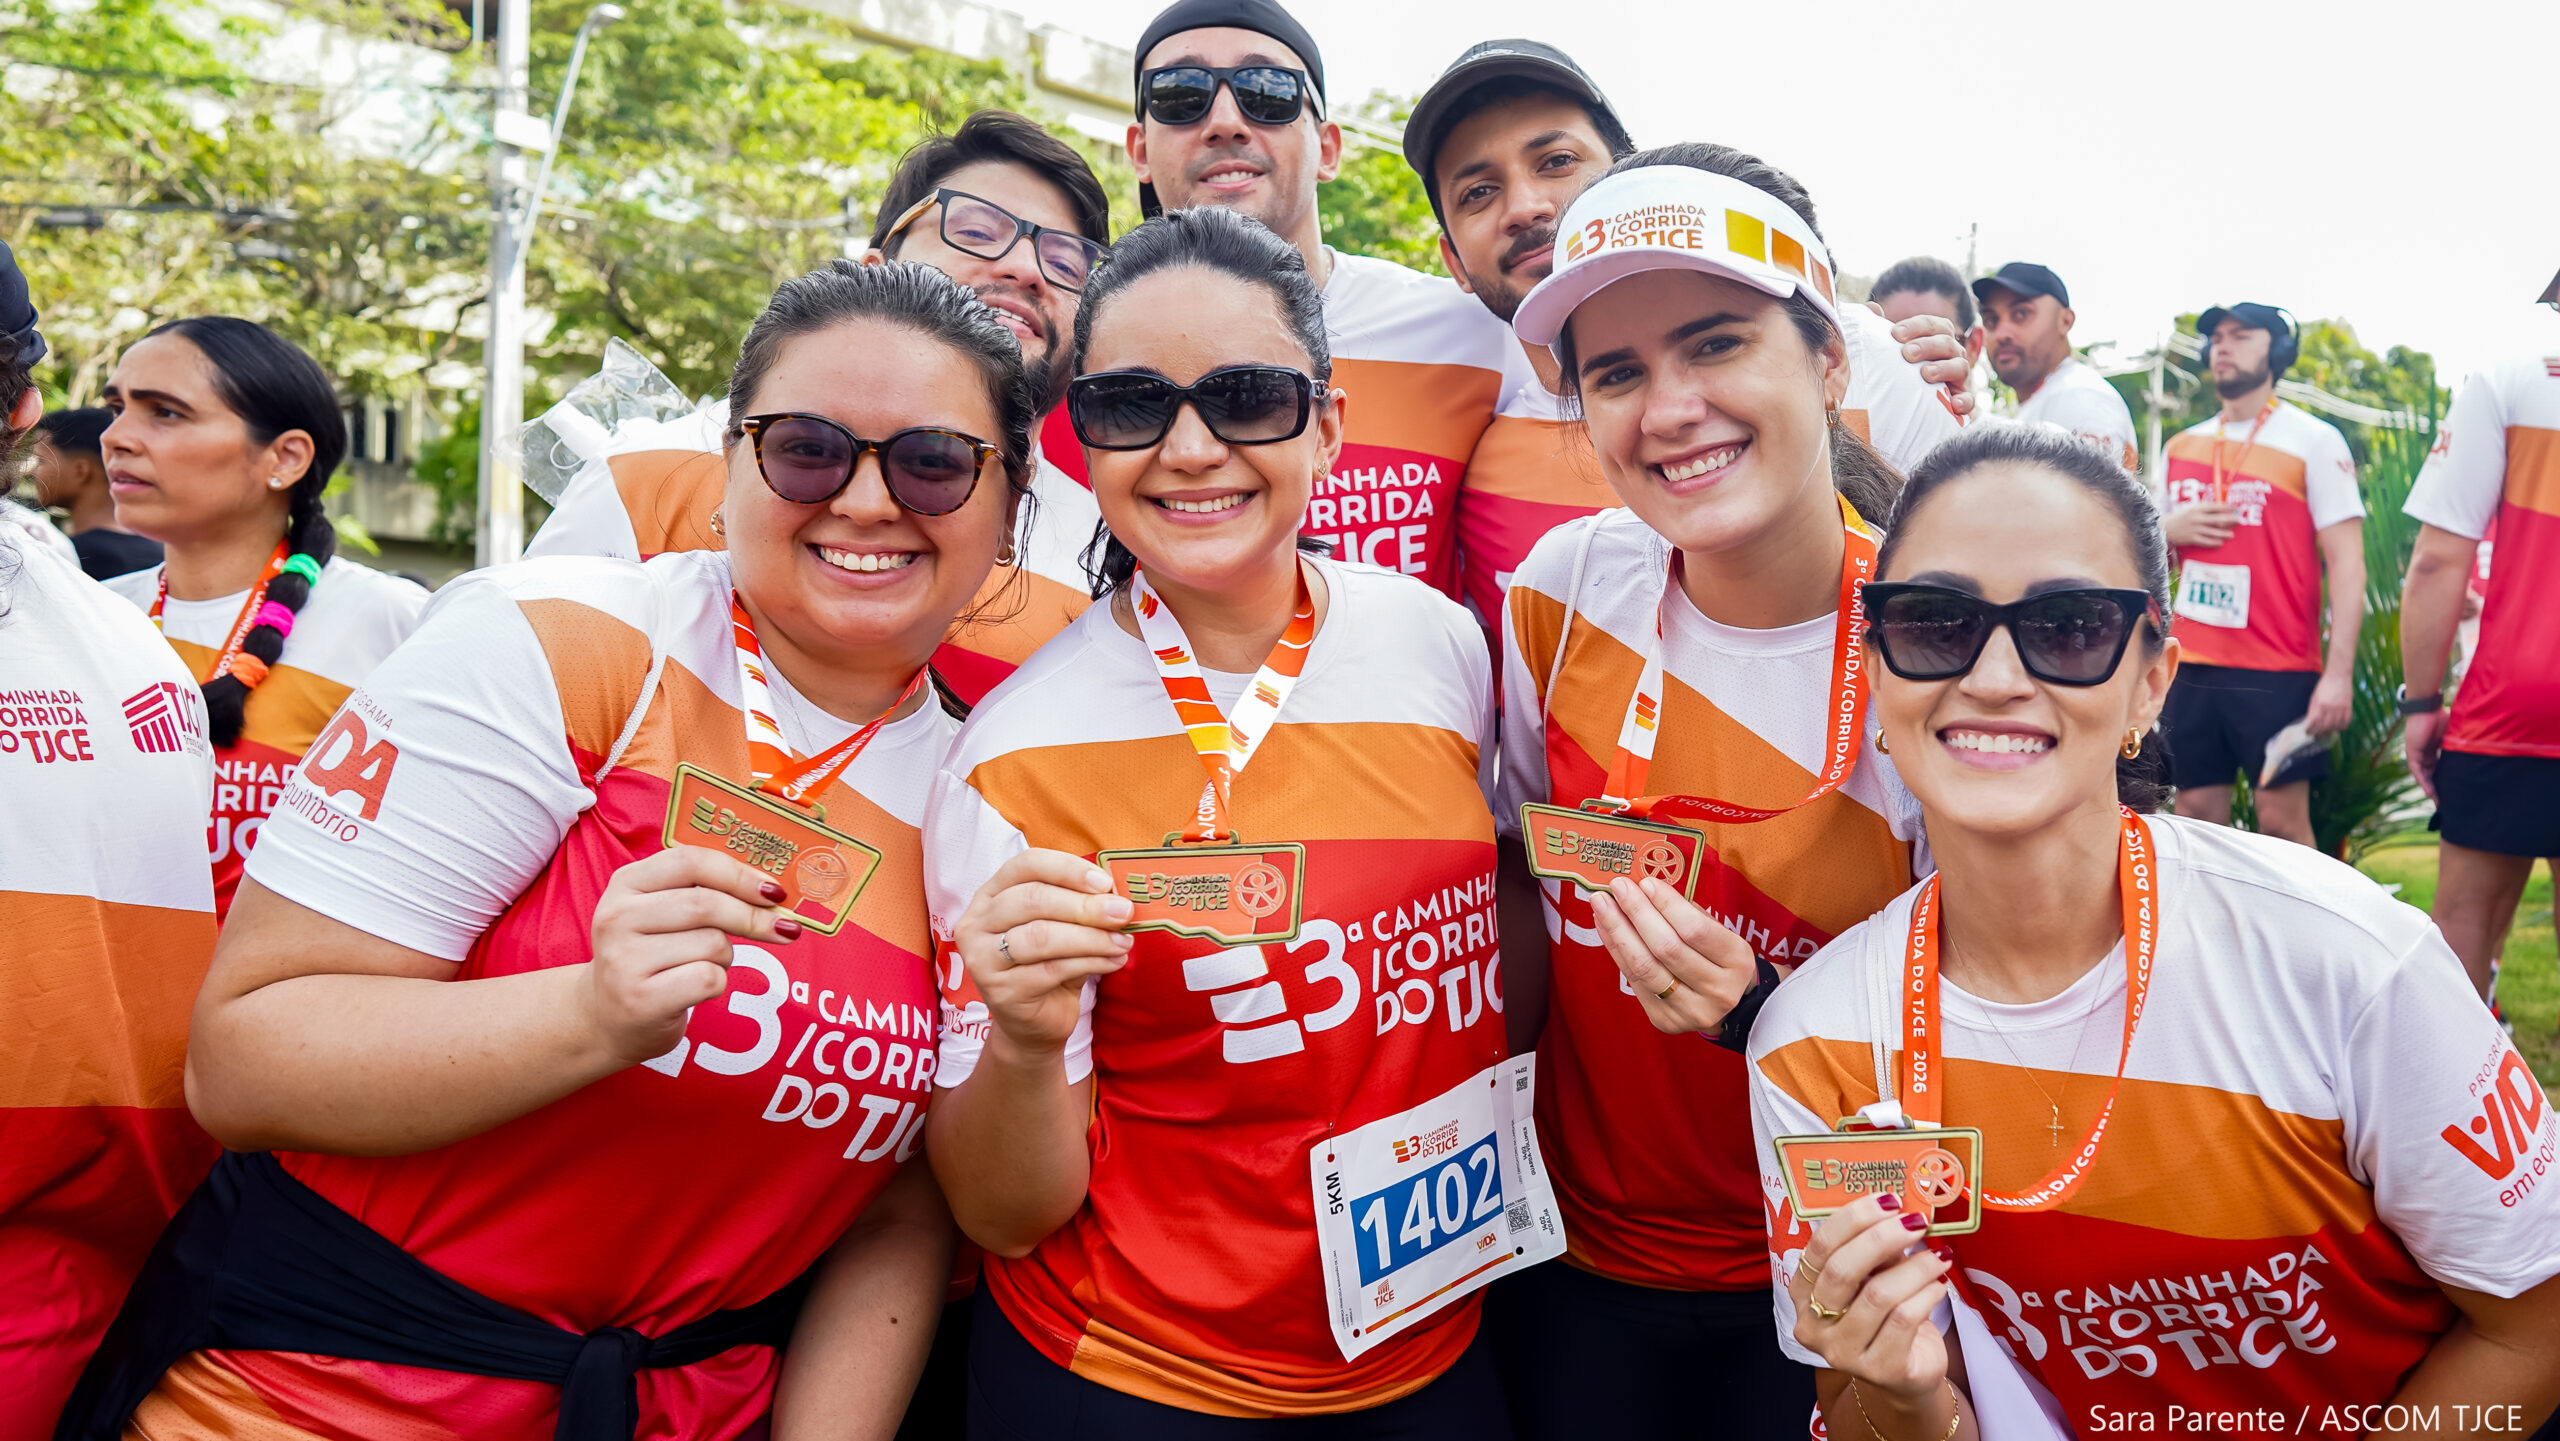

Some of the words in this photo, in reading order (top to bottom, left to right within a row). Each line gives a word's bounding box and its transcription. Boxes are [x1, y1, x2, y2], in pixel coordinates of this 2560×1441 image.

[1610, 214, 1705, 239] /CORRIDA
[1615, 204, 1707, 224] CAMINHADA
[1310, 462, 1442, 497] INHADA
[0, 690, 83, 705] MINHADA
[0, 706, 88, 727] ORRIDA
[20, 729, 94, 763] TJCE
[730, 827, 793, 861] /CORRIDA
[739, 818, 799, 853] CAMINHADA
[1584, 836, 1637, 852] CAMINHADA
[2125, 828, 2146, 862] TJCE
[726, 837, 748, 853] DO
[746, 847, 789, 876] TJCE
[1579, 853, 1596, 864] DO
[1597, 856, 1632, 875] TJCE
[1580, 845, 1634, 861] /CORRIDA
[1168, 882, 1230, 895] /CORRIDA
[1172, 873, 1231, 885] CAMINHADA
[2133, 863, 2150, 891] DO
[1169, 896, 1188, 907] DO
[1189, 894, 1229, 911] TJCE
[1286, 918, 1364, 1033] 3ª
[1912, 965, 1924, 993] DO
[693, 944, 810, 1076] 3ª
[818, 990, 933, 1042] CAMIN
[1375, 978, 1435, 1037] DO
[1438, 950, 1504, 1033] TJC
[1912, 998, 1926, 1037] TJCE
[785, 1022, 937, 1093] /CORR
[1913, 1050, 1927, 1093] 2026
[761, 1074, 850, 1129] DO
[842, 1093, 928, 1163] TJC
[1423, 1118, 1459, 1140] CAMINHADA
[2440, 1050, 2544, 1181] VID
[1422, 1126, 1459, 1149] /CORRIDA
[1422, 1146, 1435, 1158] DO
[1435, 1134, 1459, 1155] TJCE
[1845, 1169, 1906, 1181] /CORRIDA
[1848, 1159, 1907, 1170] CAMINHADA
[1326, 1171, 1344, 1215] 5KM
[1845, 1182, 1865, 1194] DO
[2500, 1172, 2536, 1208] em
[1359, 1143, 1501, 1271] 1402
[2054, 1243, 2329, 1314] CAMINHADA
[1374, 1290, 1395, 1308] TJCE
[2058, 1271, 2324, 1346] /CORRIDA
[2071, 1344, 2158, 1380] DO
[2158, 1300, 2337, 1371] TJCE
